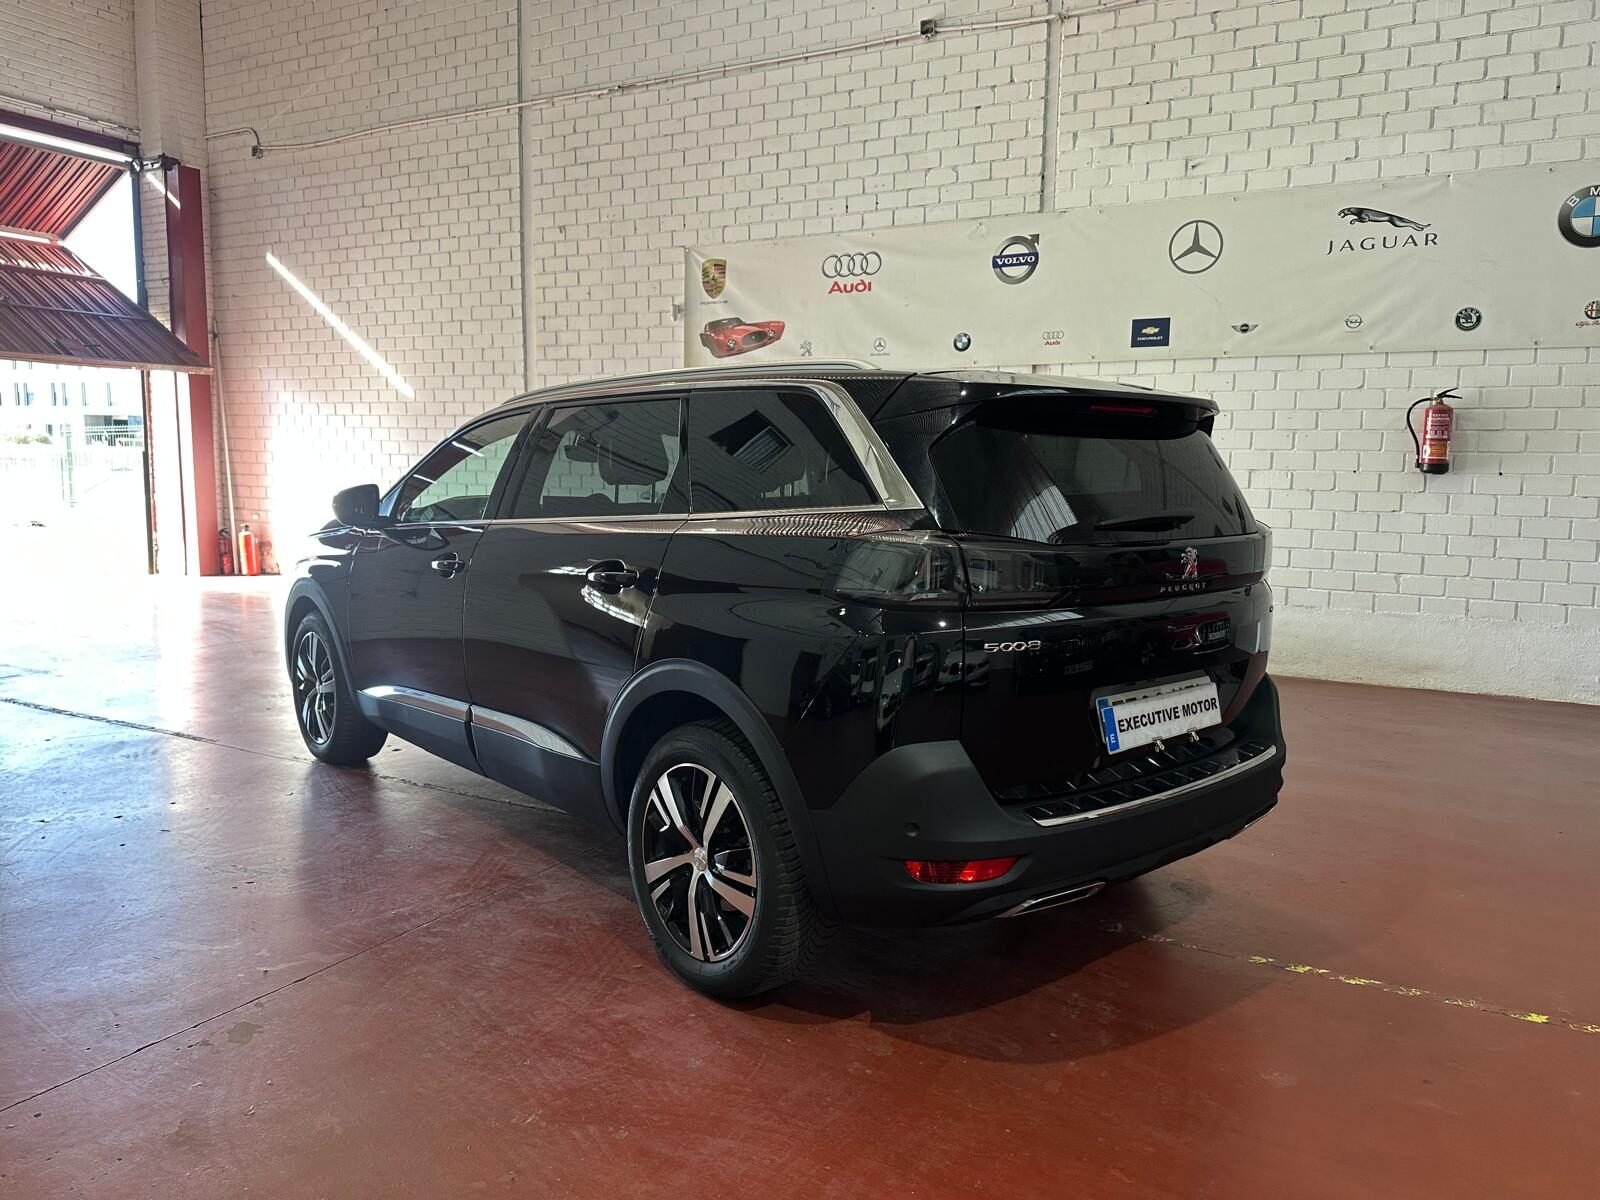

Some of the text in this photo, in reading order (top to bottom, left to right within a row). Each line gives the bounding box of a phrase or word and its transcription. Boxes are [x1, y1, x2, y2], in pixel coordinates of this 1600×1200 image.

[1327, 233, 1438, 255] JAGUAR
[995, 255, 1035, 265] VOLVO
[828, 280, 872, 294] Audi
[1160, 582, 1207, 593] PEUGEOT
[984, 640, 1042, 653] 5008
[1118, 697, 1218, 733] EXECUTIVE MOTOR
[1109, 734, 1116, 743] E
